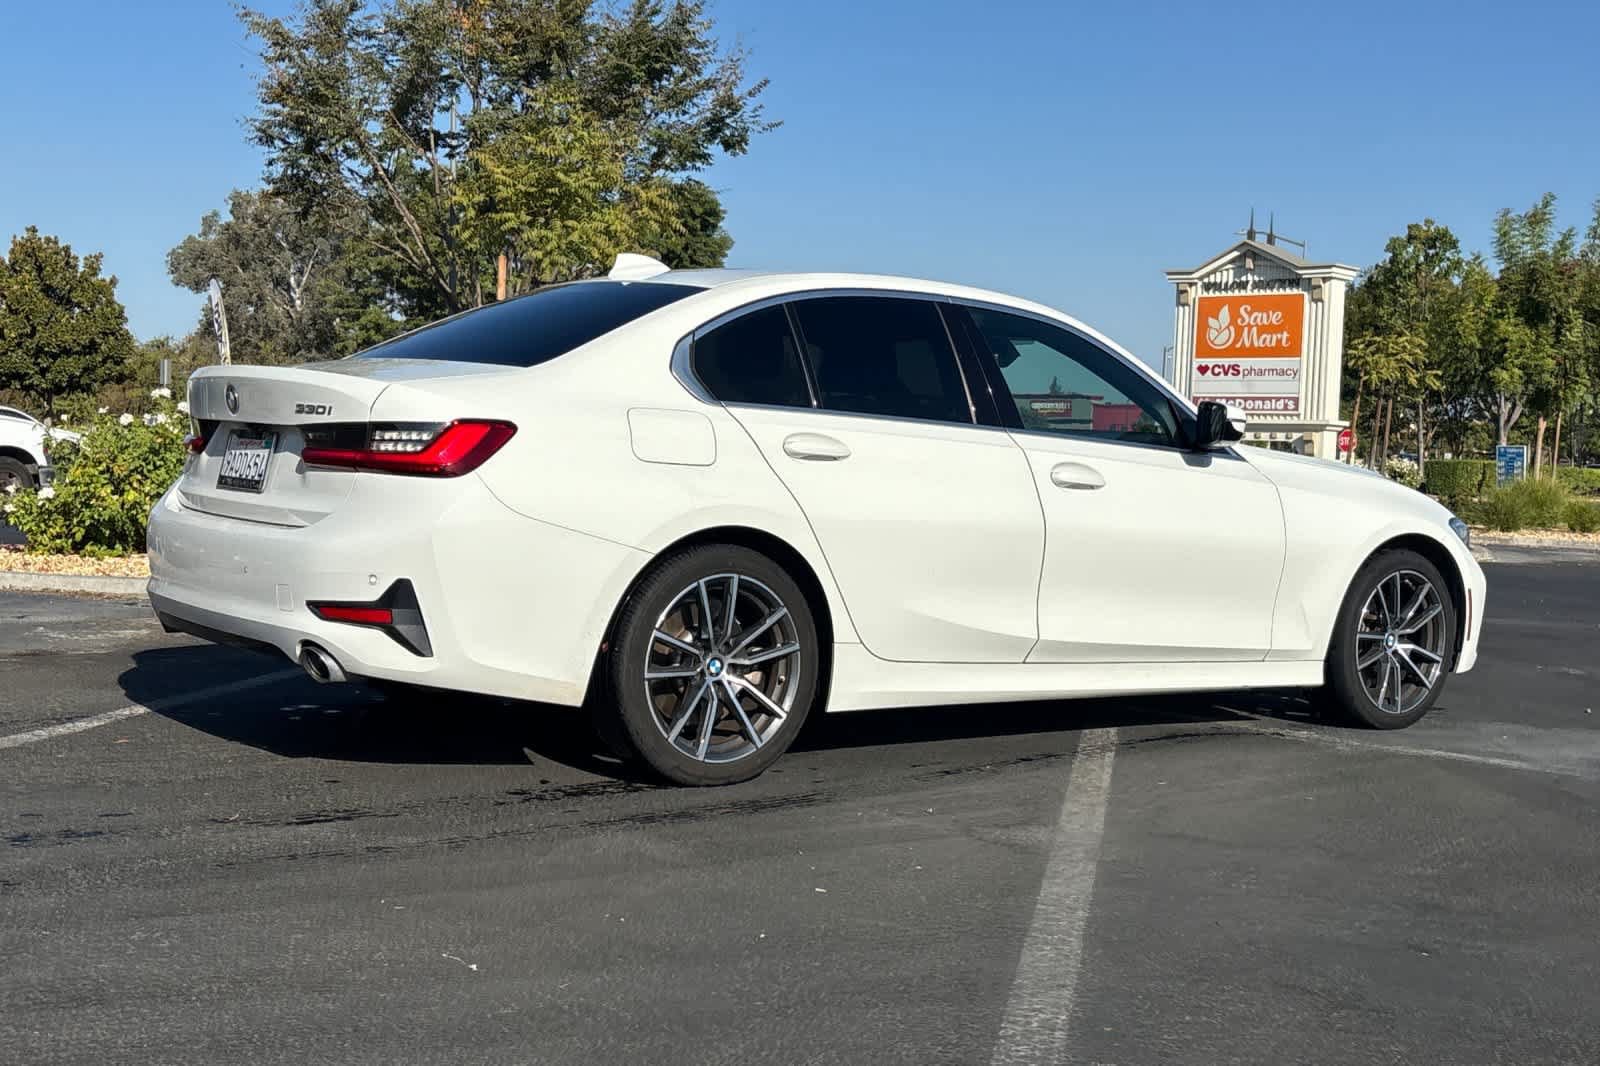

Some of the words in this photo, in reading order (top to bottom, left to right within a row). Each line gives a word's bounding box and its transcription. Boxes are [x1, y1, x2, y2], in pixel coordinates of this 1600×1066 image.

[1237, 304, 1283, 326] Save
[1235, 326, 1291, 348] Mart
[1211, 364, 1240, 376] CVS
[1242, 365, 1299, 379] pharmacy
